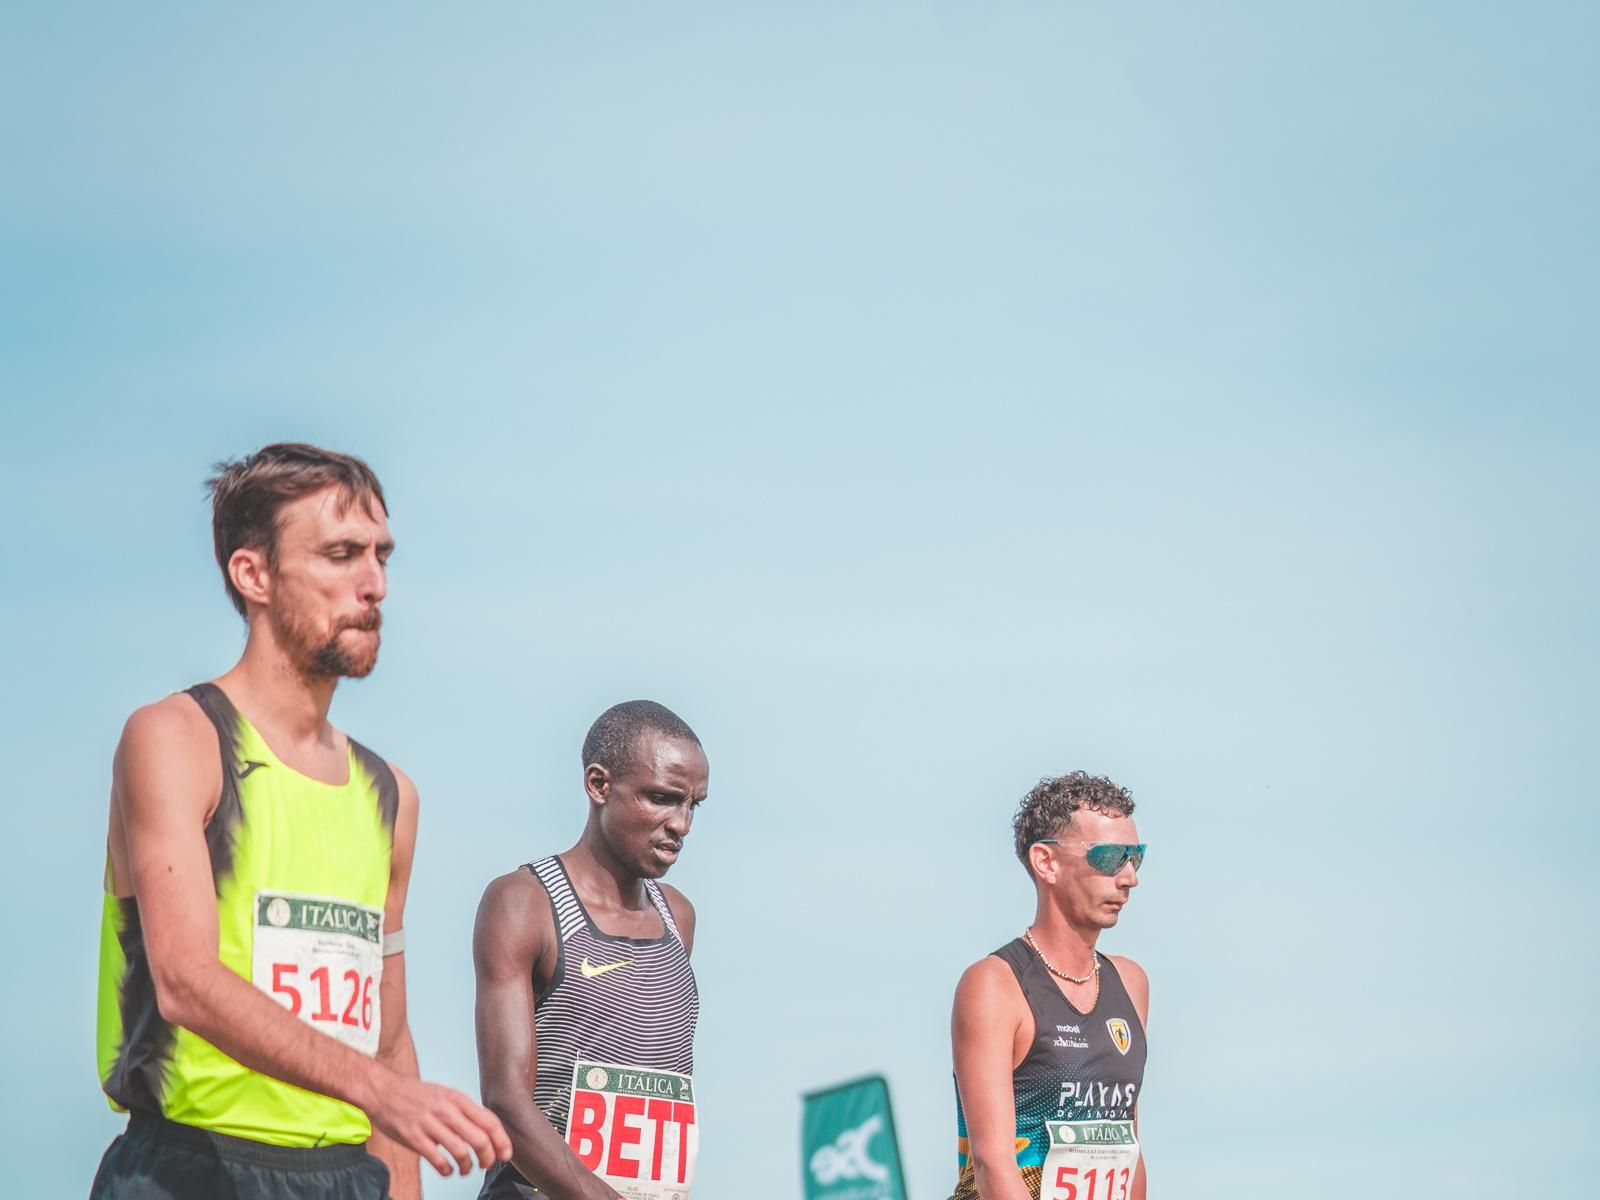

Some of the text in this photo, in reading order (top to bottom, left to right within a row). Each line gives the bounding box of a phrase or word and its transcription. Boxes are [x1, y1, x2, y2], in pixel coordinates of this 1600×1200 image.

[302, 903, 364, 932] ITÁLICA
[271, 962, 373, 1031] 5126
[617, 1072, 673, 1095] ITÁLICA
[1059, 1081, 1136, 1107] PLAYAS
[568, 1090, 695, 1184] BETT
